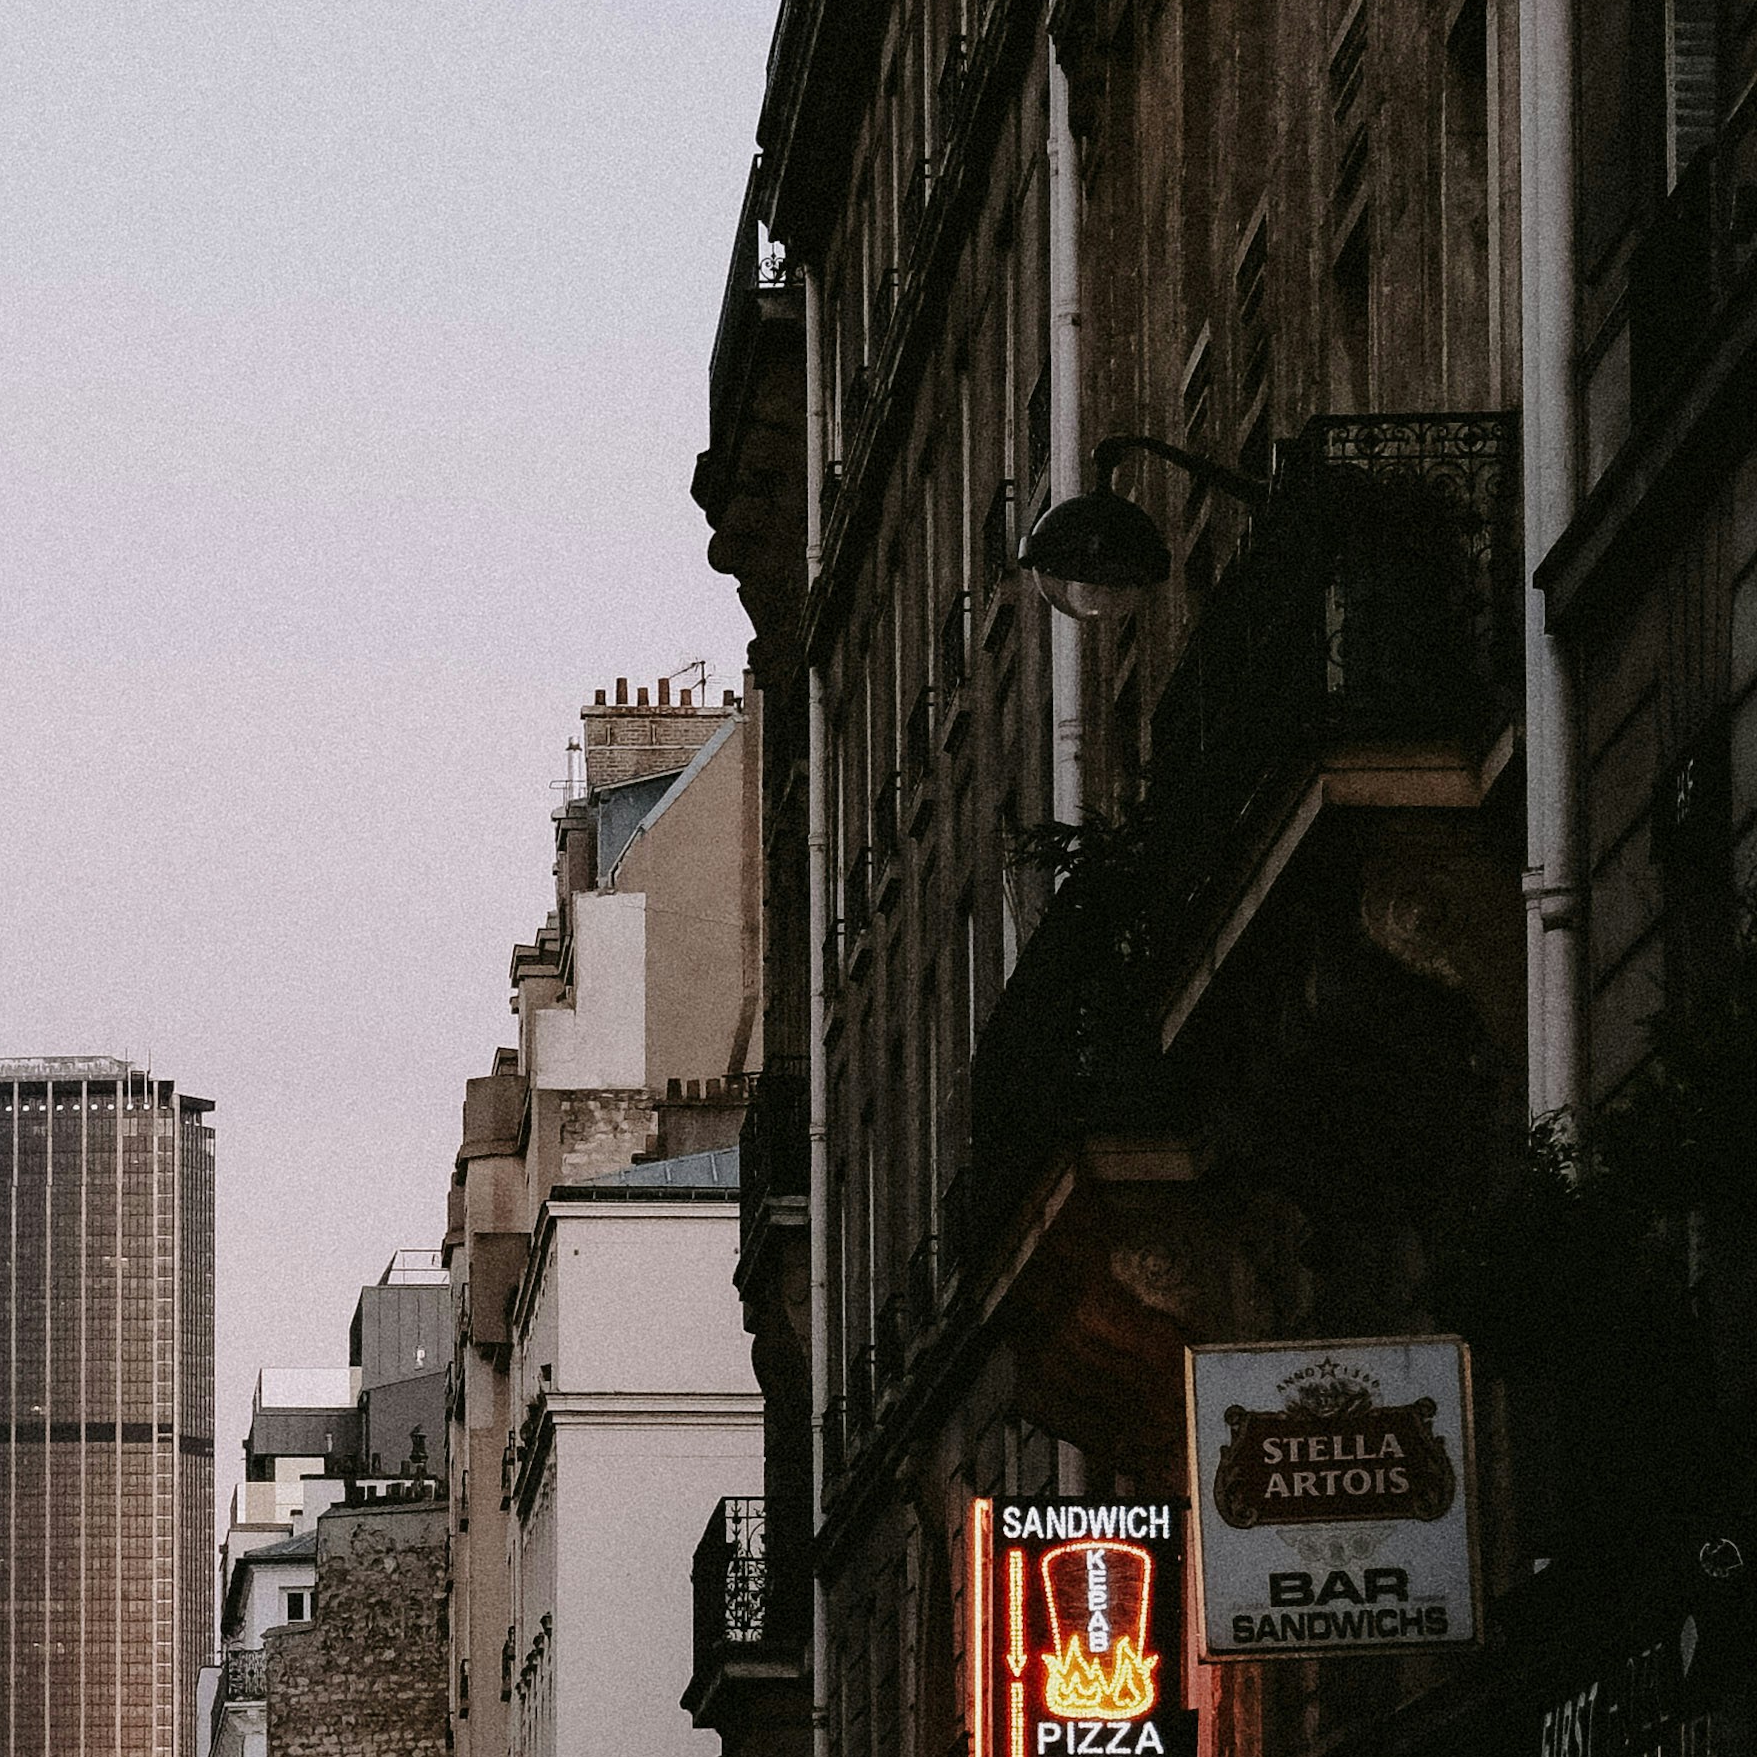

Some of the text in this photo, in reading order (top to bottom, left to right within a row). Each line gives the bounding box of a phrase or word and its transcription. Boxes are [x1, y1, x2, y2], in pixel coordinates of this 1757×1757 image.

[1276, 1367, 1315, 1393] ANNO
[1261, 1433, 1405, 1465] STELLA
[1264, 1466, 1411, 1499] ARTOIS
[1002, 1504, 1171, 1540] SANDWICH
[1085, 1548, 1111, 1654] KEBAB
[1269, 1568, 1409, 1608] BAR
[1232, 1605, 1448, 1644] SANDWICHS
[1037, 1721, 1165, 1755] PIZZA
